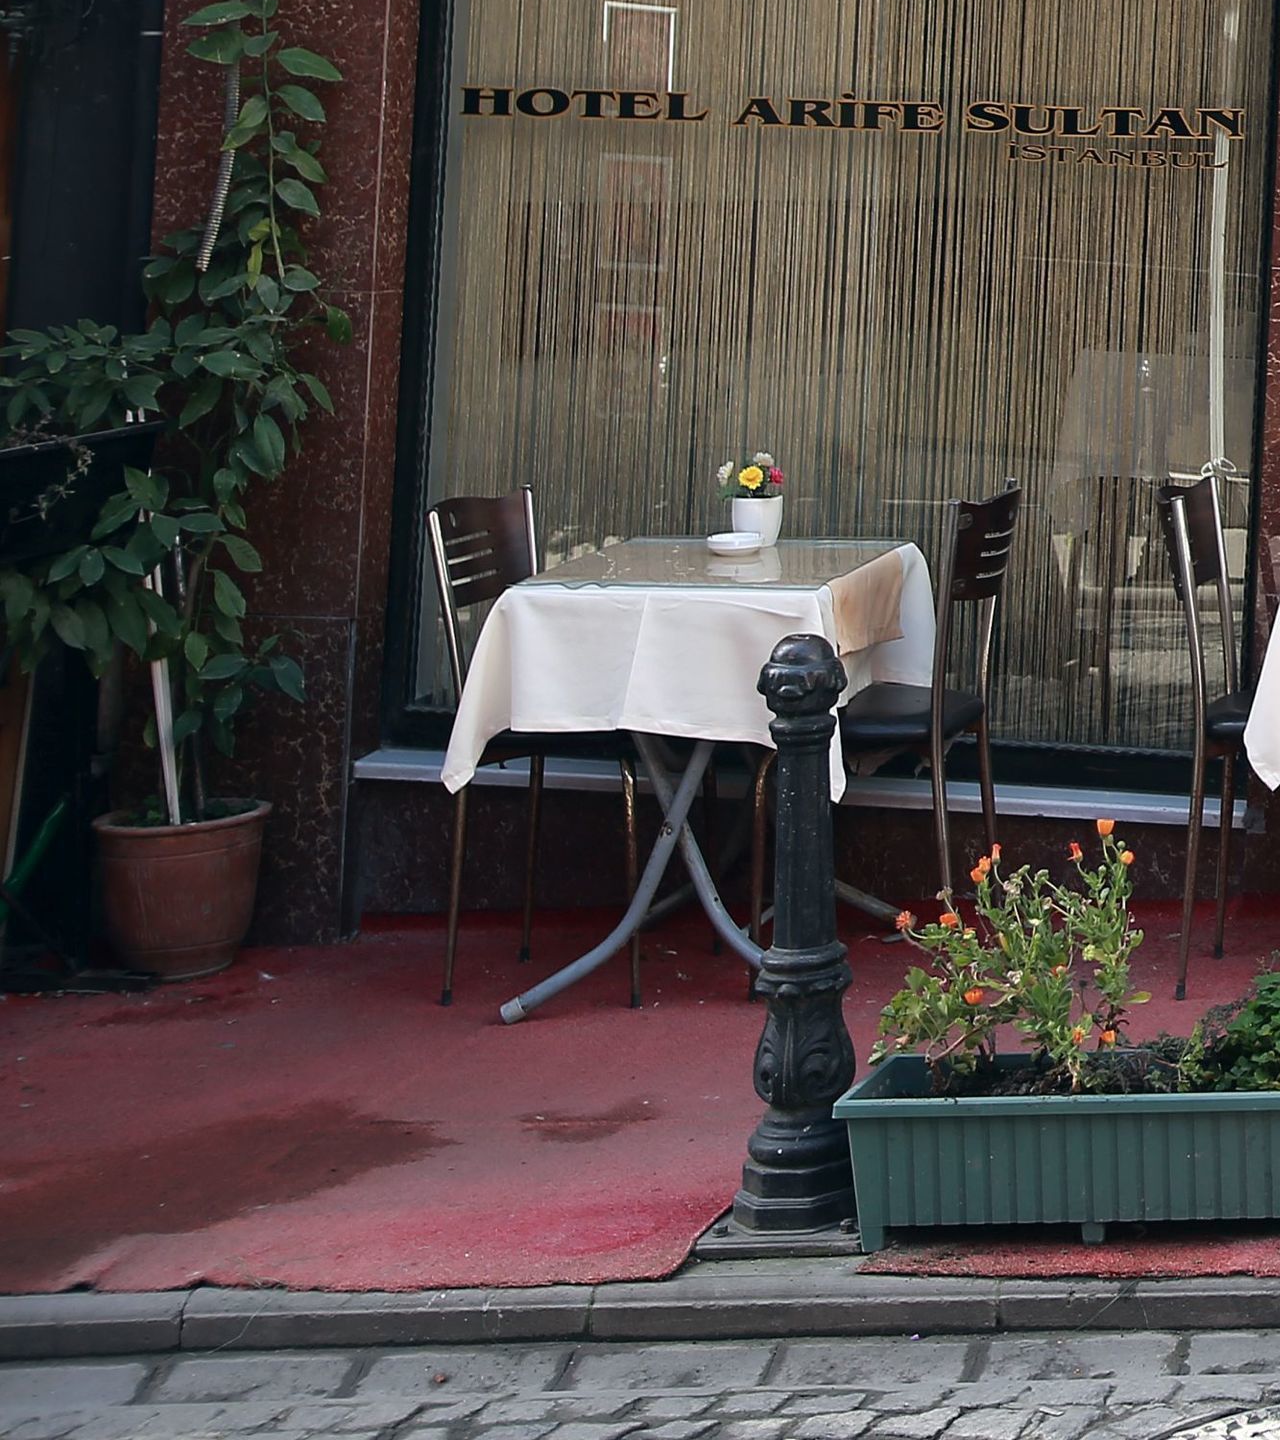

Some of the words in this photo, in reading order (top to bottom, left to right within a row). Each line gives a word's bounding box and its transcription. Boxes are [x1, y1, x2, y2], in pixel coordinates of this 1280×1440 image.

[459, 86, 709, 123] HOTEL
[732, 91, 945, 133] ARİFE
[965, 101, 1245, 140] SULTAN
[1006, 139, 1229, 170] İSTANBUL
